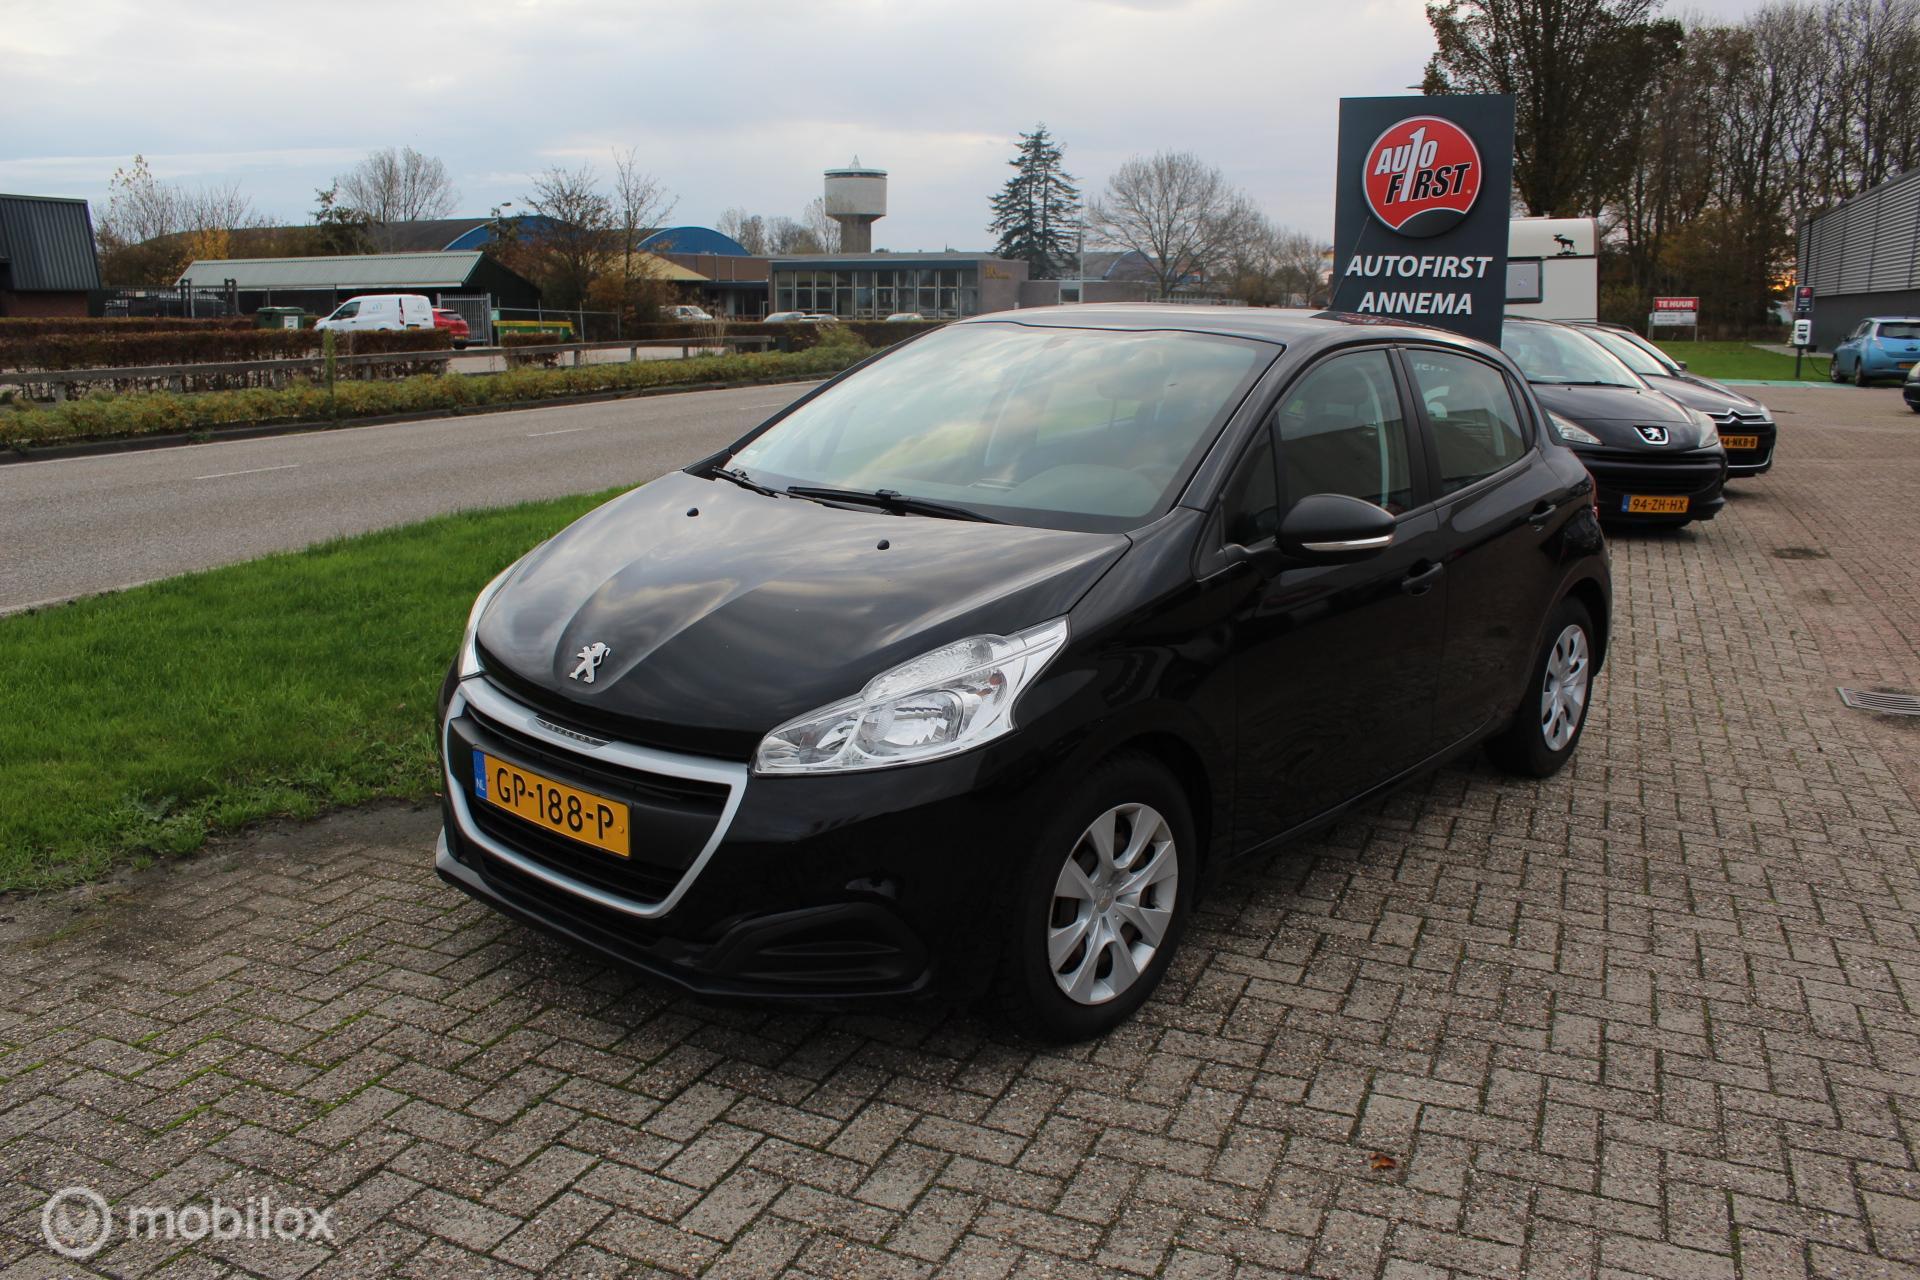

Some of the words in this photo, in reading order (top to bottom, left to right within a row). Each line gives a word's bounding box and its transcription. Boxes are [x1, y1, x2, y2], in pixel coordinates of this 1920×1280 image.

[1345, 255, 1493, 278] AUTOFIRST
[1357, 291, 1472, 315] ANNEMA
[1658, 300, 1668, 308] TE
[1669, 300, 1694, 308] HUUR
[1633, 498, 1686, 511] 94-ZH-HX
[475, 777, 486, 791] NL
[496, 767, 614, 840] GP-188-P
